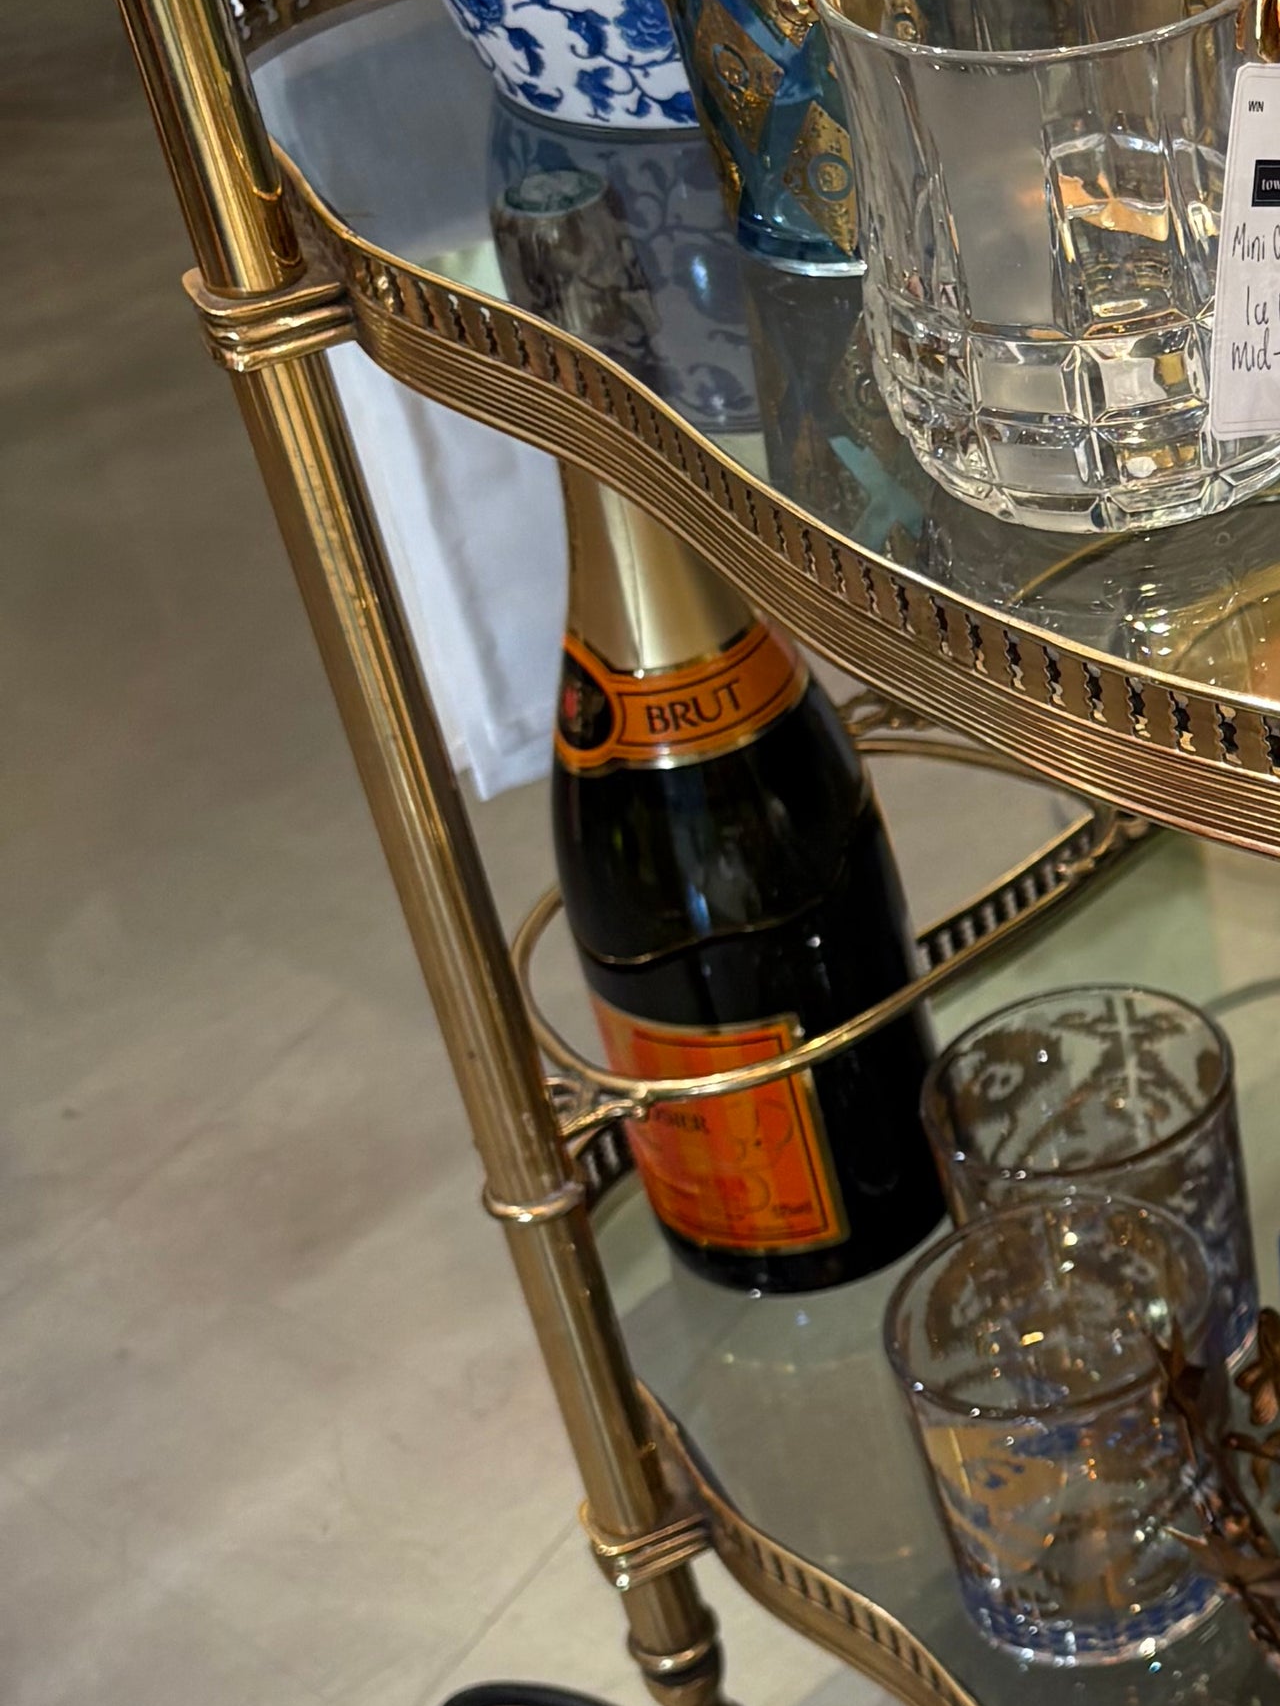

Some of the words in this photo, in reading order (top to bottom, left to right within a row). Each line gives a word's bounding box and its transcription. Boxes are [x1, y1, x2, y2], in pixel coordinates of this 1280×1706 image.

[1248, 100, 1265, 113] WN
[1232, 222, 1265, 262] Mini
[1246, 285, 1270, 326] Ice
[646, 678, 741, 735] BRUT
